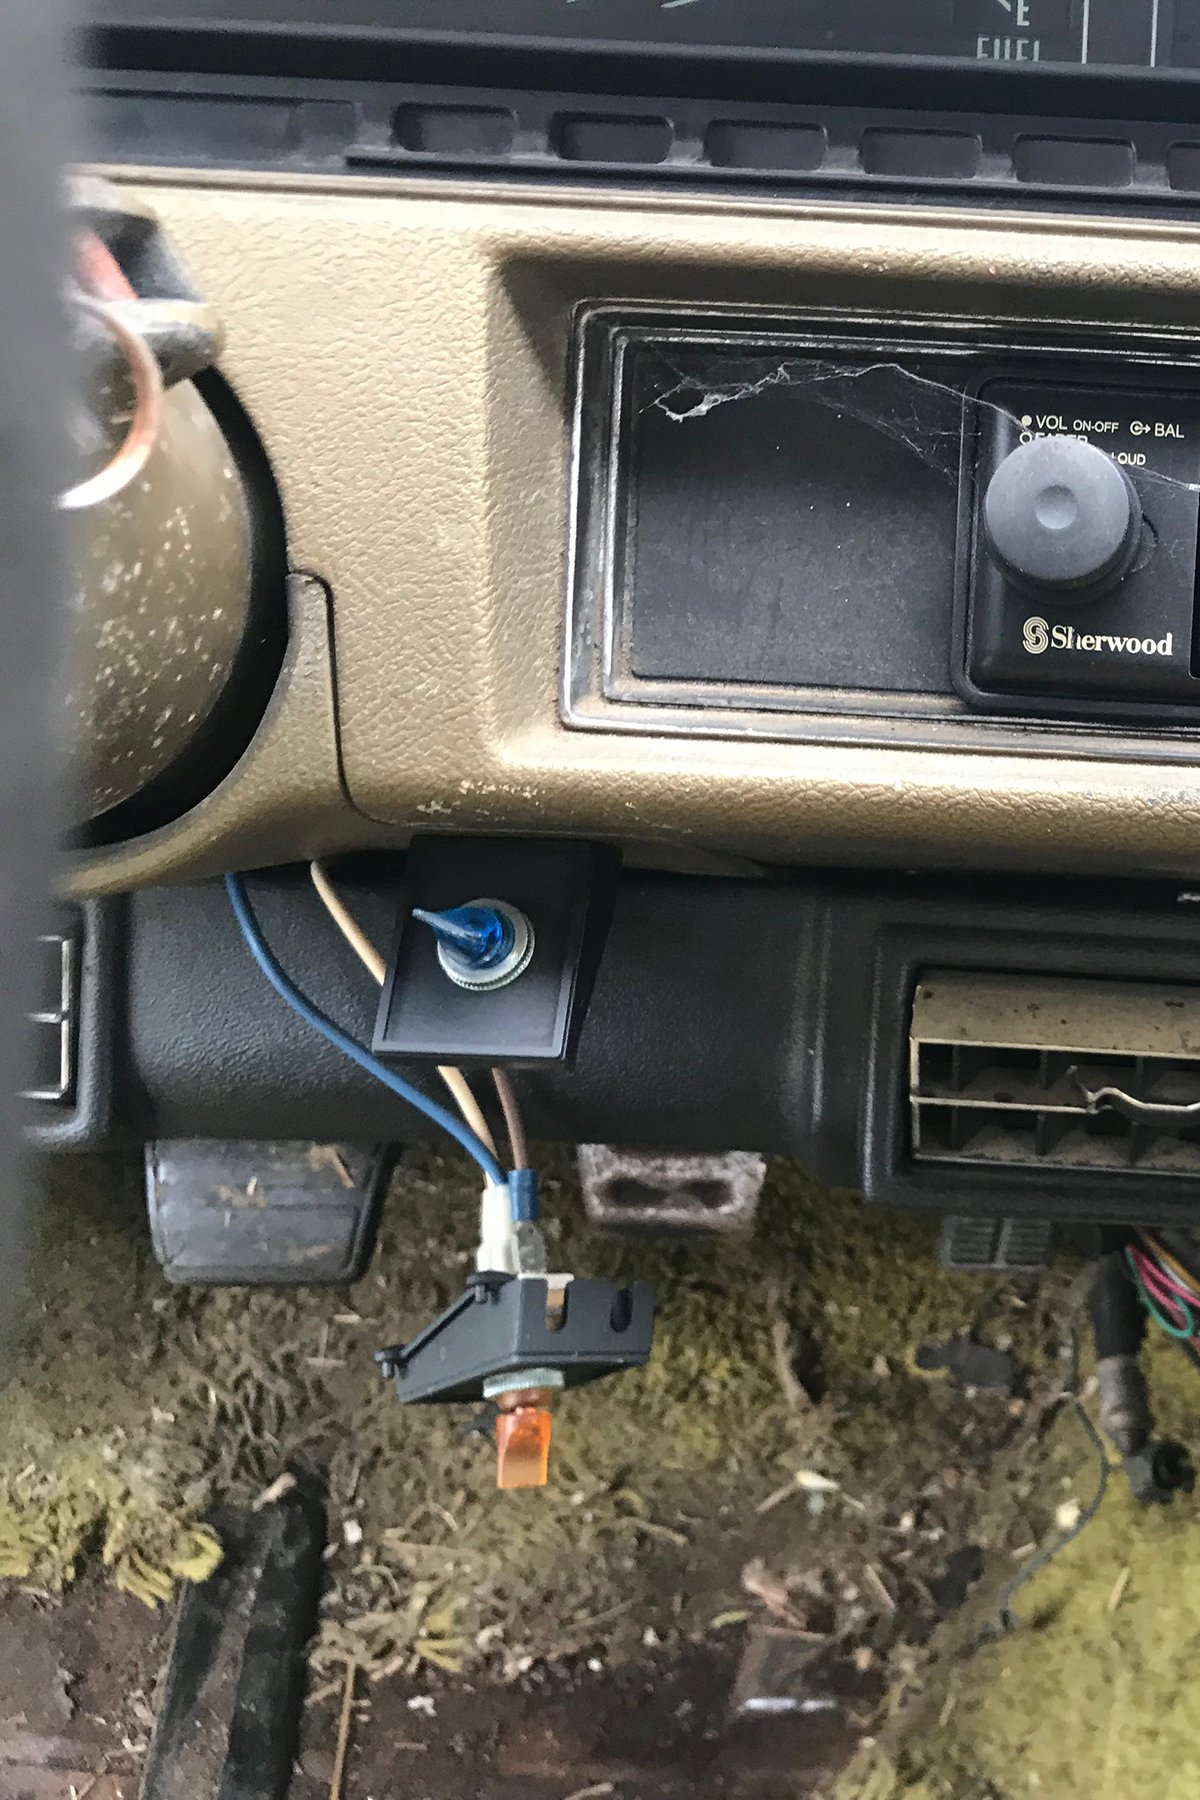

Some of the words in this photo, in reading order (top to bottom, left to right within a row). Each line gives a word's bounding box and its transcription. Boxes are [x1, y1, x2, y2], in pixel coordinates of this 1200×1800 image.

[1036, 415, 1068, 431] VOL
[1073, 419, 1119, 433] ON-OFF
[1154, 423, 1185, 439] BAL
[1051, 625, 1173, 656] Sherwood
